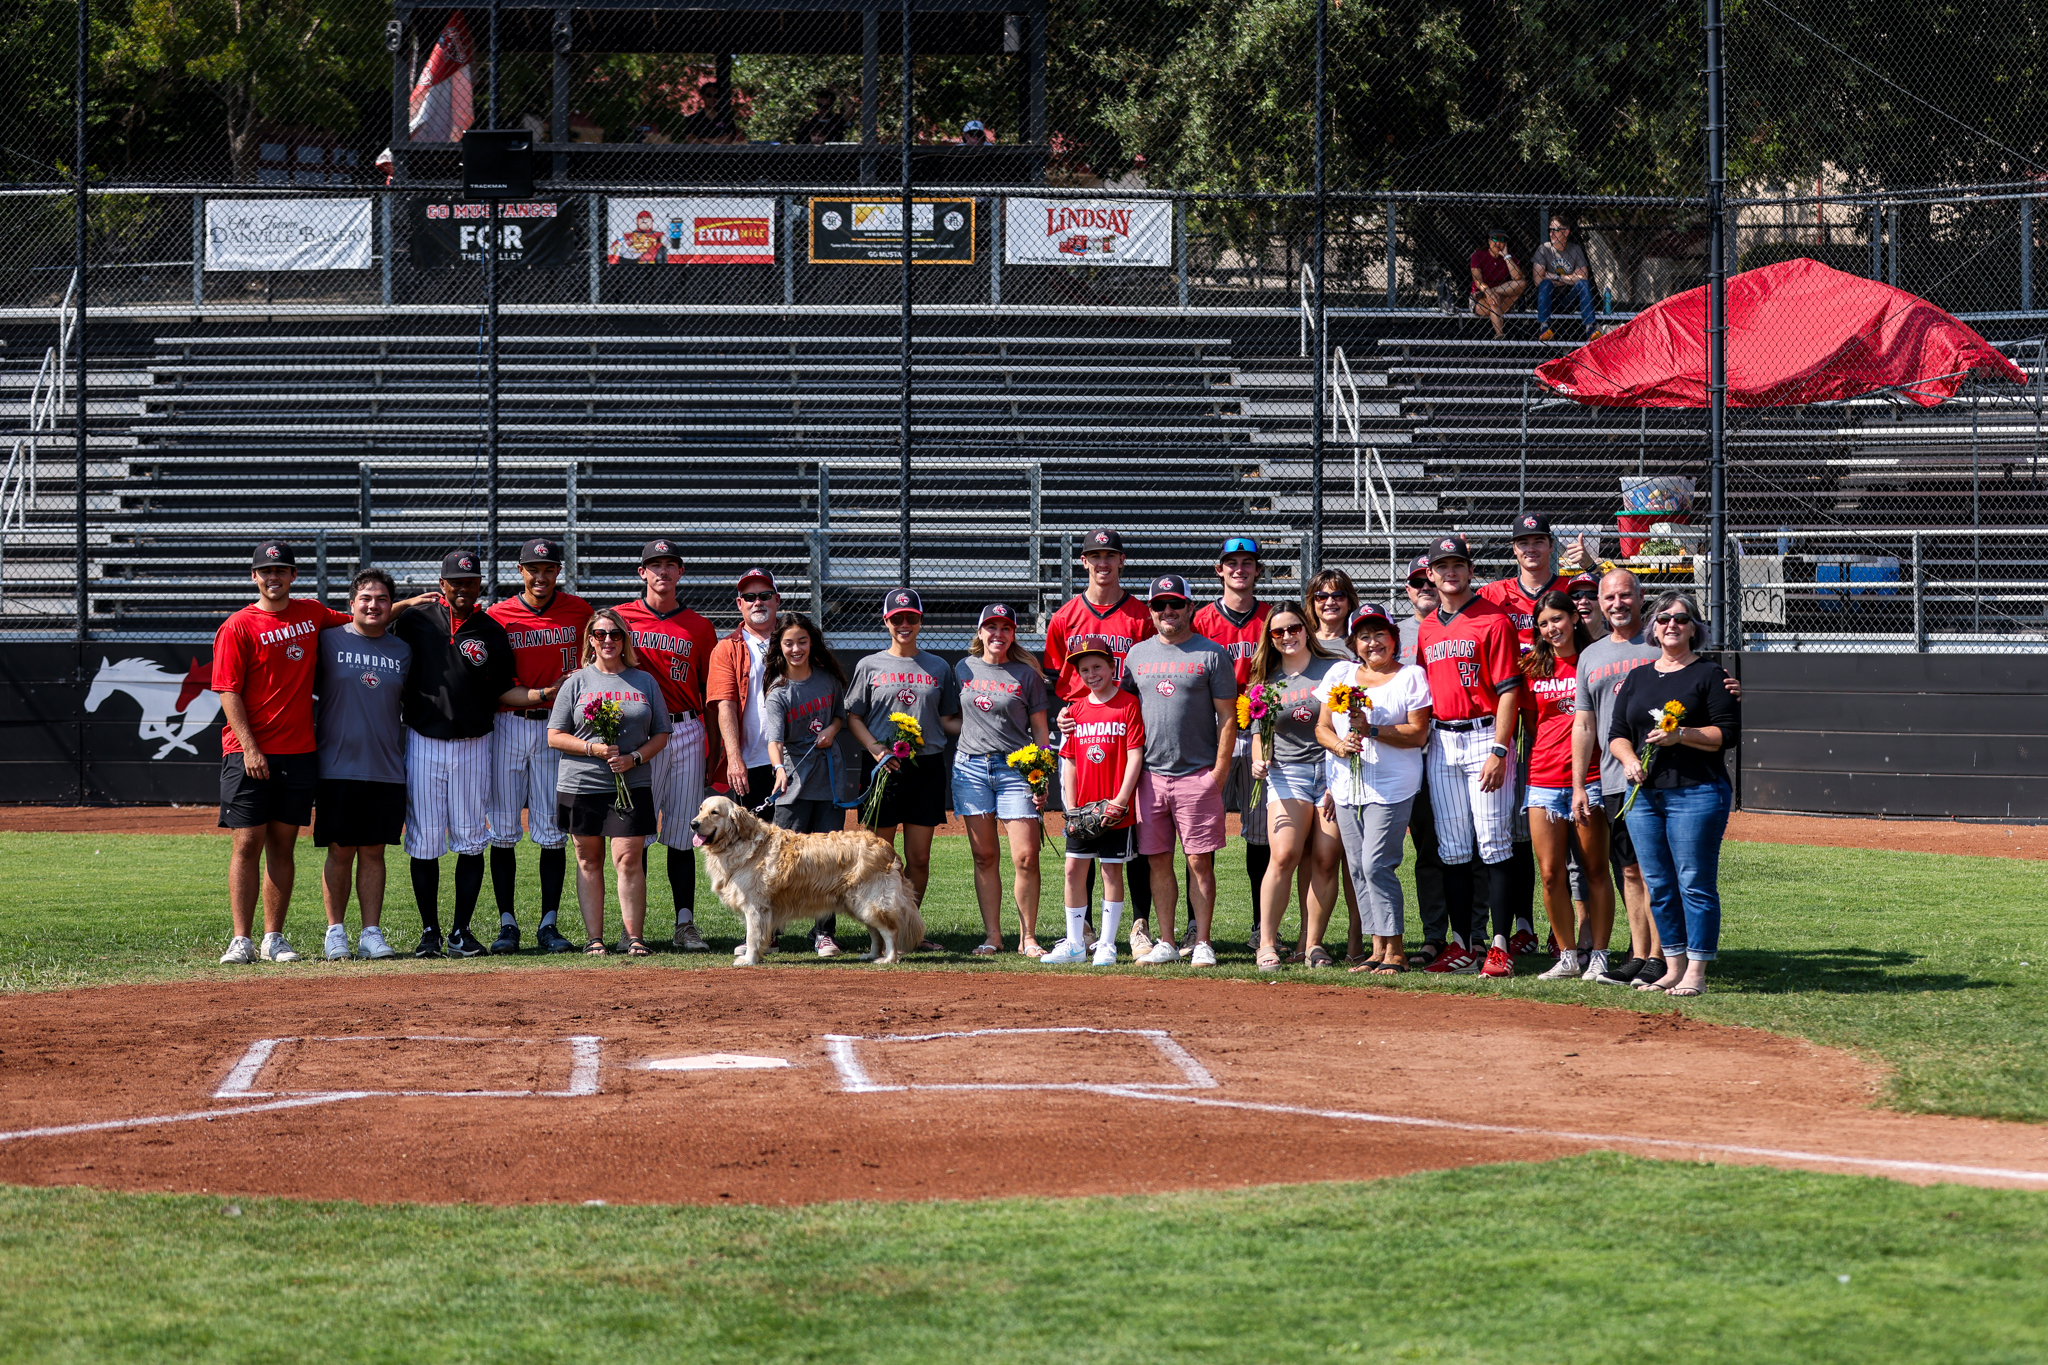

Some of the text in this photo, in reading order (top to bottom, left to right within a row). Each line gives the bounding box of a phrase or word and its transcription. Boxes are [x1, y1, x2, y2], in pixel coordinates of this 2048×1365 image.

[426, 204, 450, 219] GO
[460, 225, 523, 250] FOR
[879, 250, 918, 258] MUSTAS!
[260, 620, 316, 645] CRAWDADS
[507, 626, 576, 649] CRAWDADS
[337, 651, 401, 673] CRAWDADS
[560, 646, 577, 672] 15
[349, 664, 392, 673] BASEBALL
[1137, 662, 1204, 675] CRAWDADS
[1458, 662, 1481, 687] 27
[873, 673, 938, 687] CRAWDADS
[1533, 677, 1577, 693] CRAWD
[579, 691, 647, 704] CRAWDADS
[1544, 689, 1577, 699] BASEBA
[1080, 736, 1116, 745] BASEBALL
